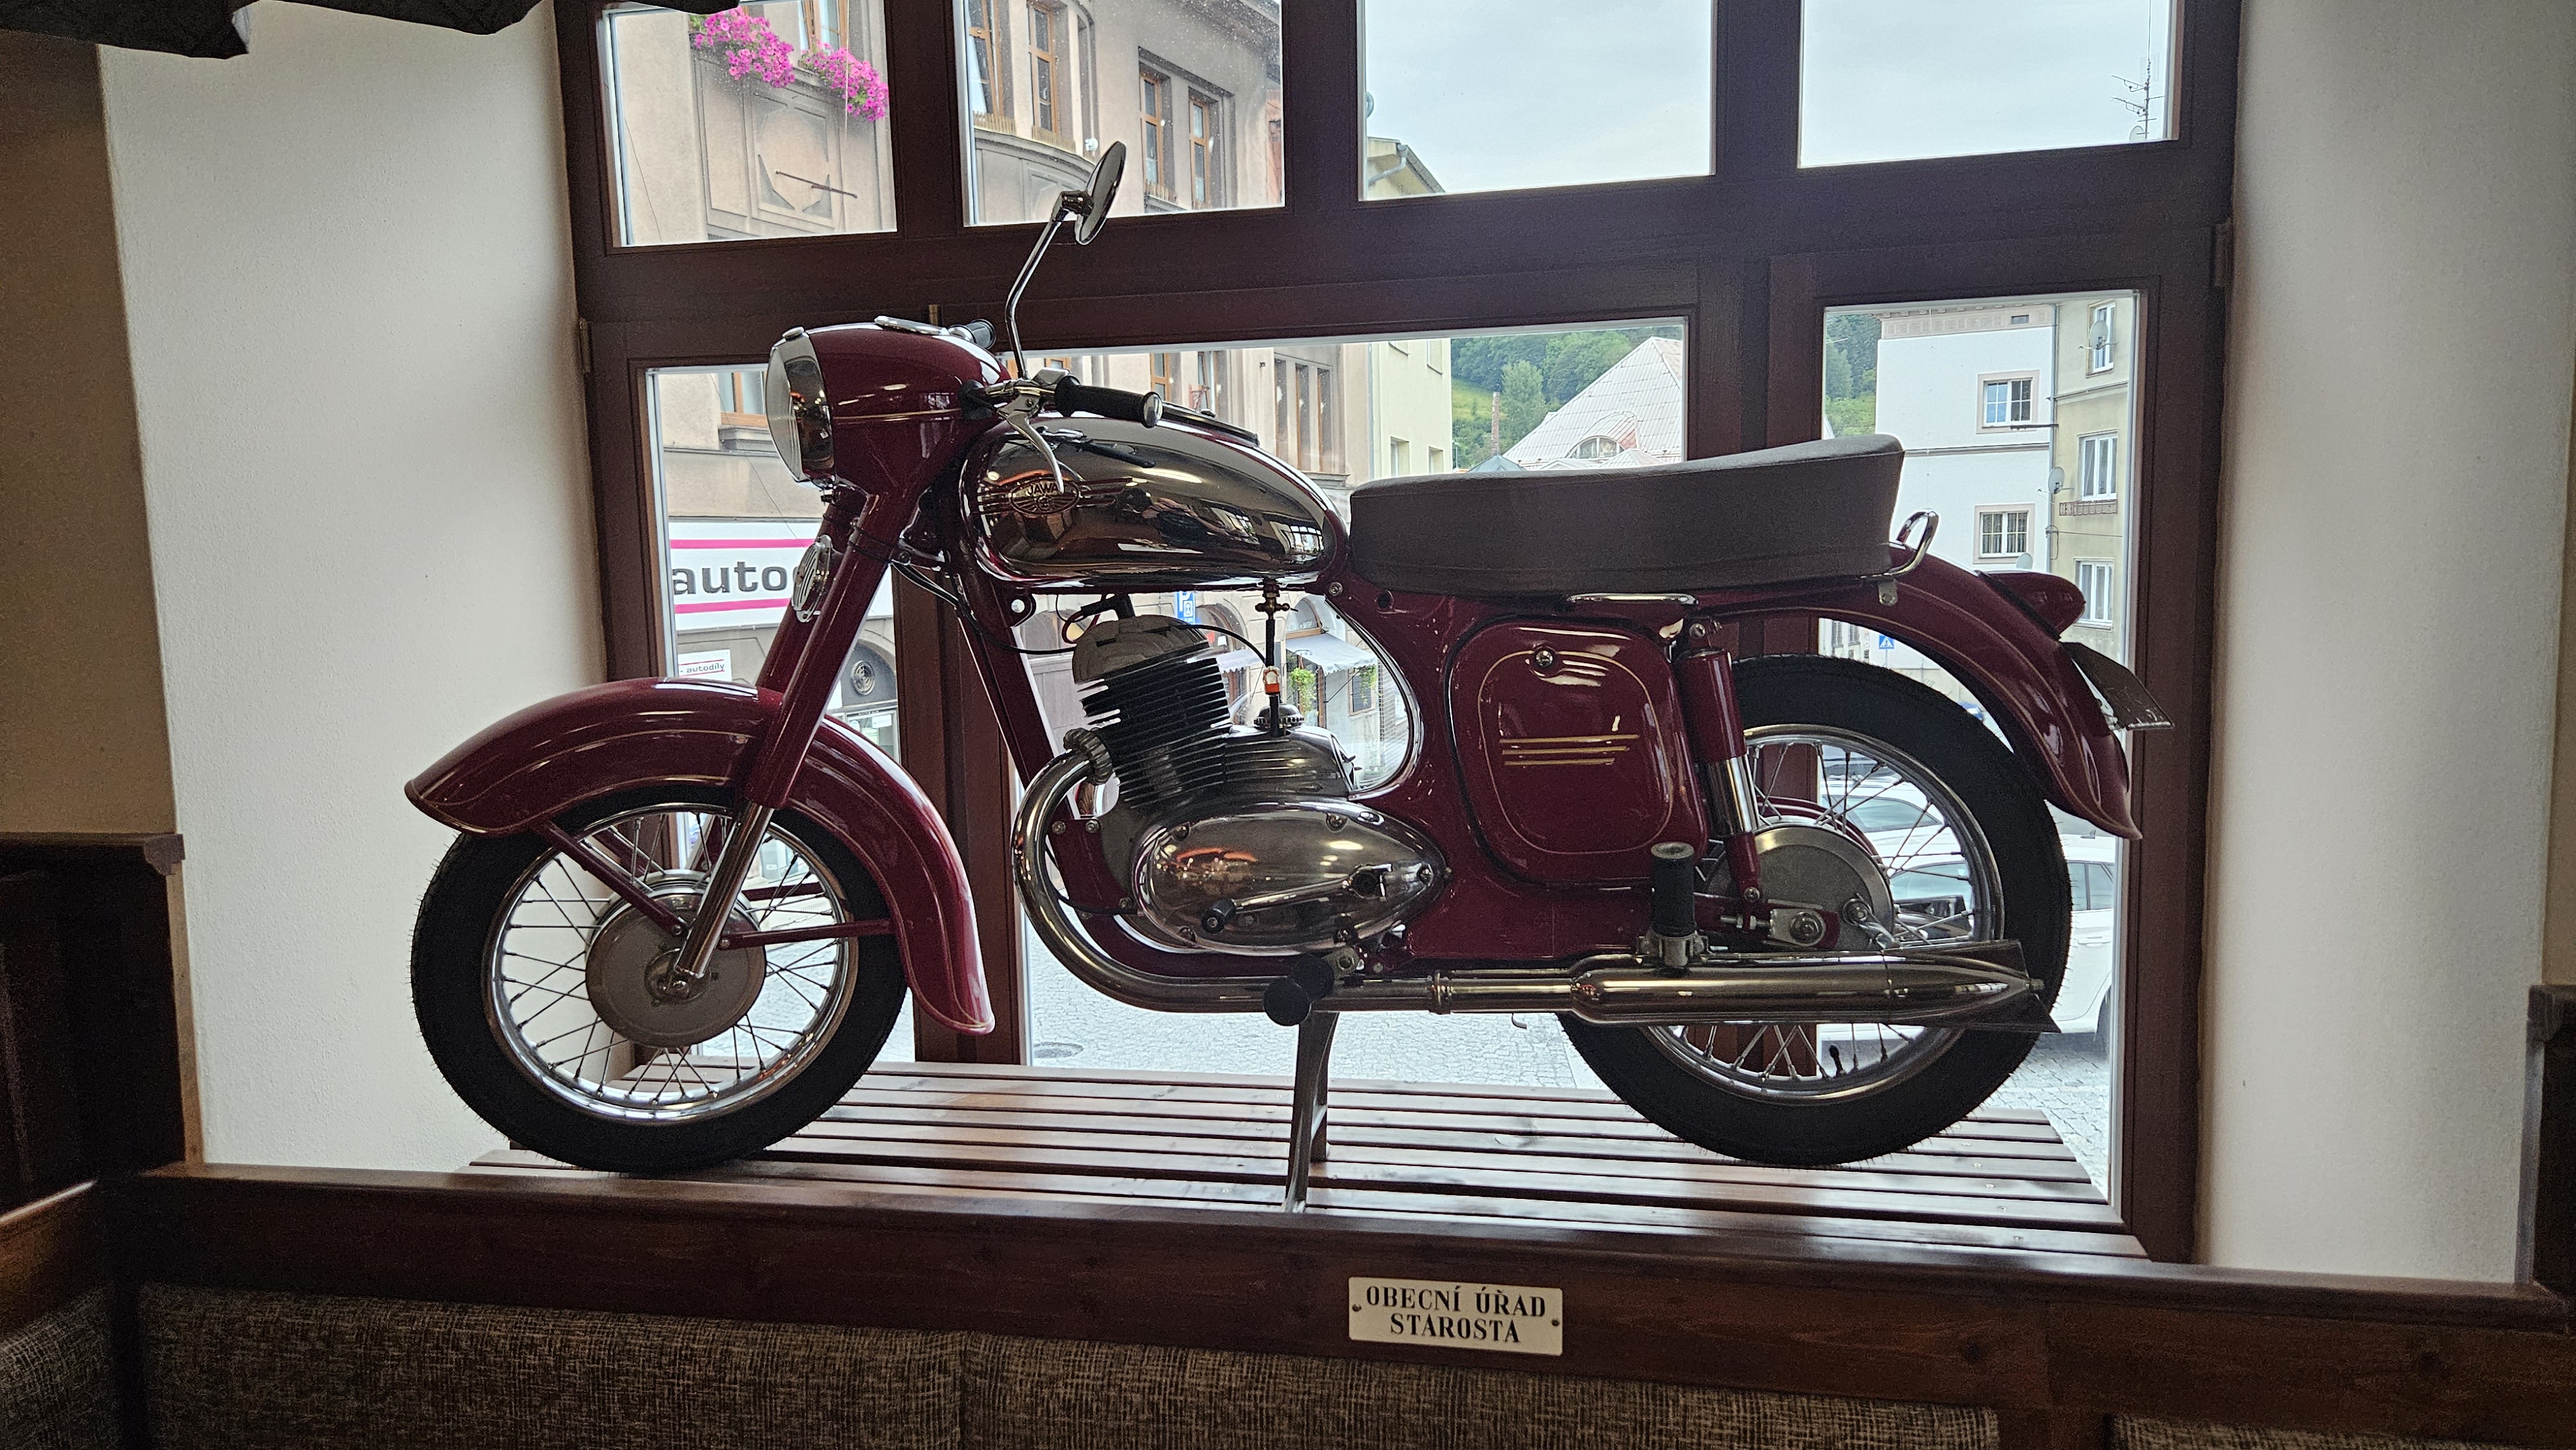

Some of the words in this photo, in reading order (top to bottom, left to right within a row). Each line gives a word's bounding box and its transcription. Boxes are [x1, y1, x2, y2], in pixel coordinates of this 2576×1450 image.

[1027, 482, 1060, 495] JAWA
[672, 561, 798, 595] auto
[1366, 1285, 1462, 1312] OBECNÍ
[1474, 1286, 1546, 1317] ÚŘAD
[1390, 1312, 1520, 1343] STAROSTA
